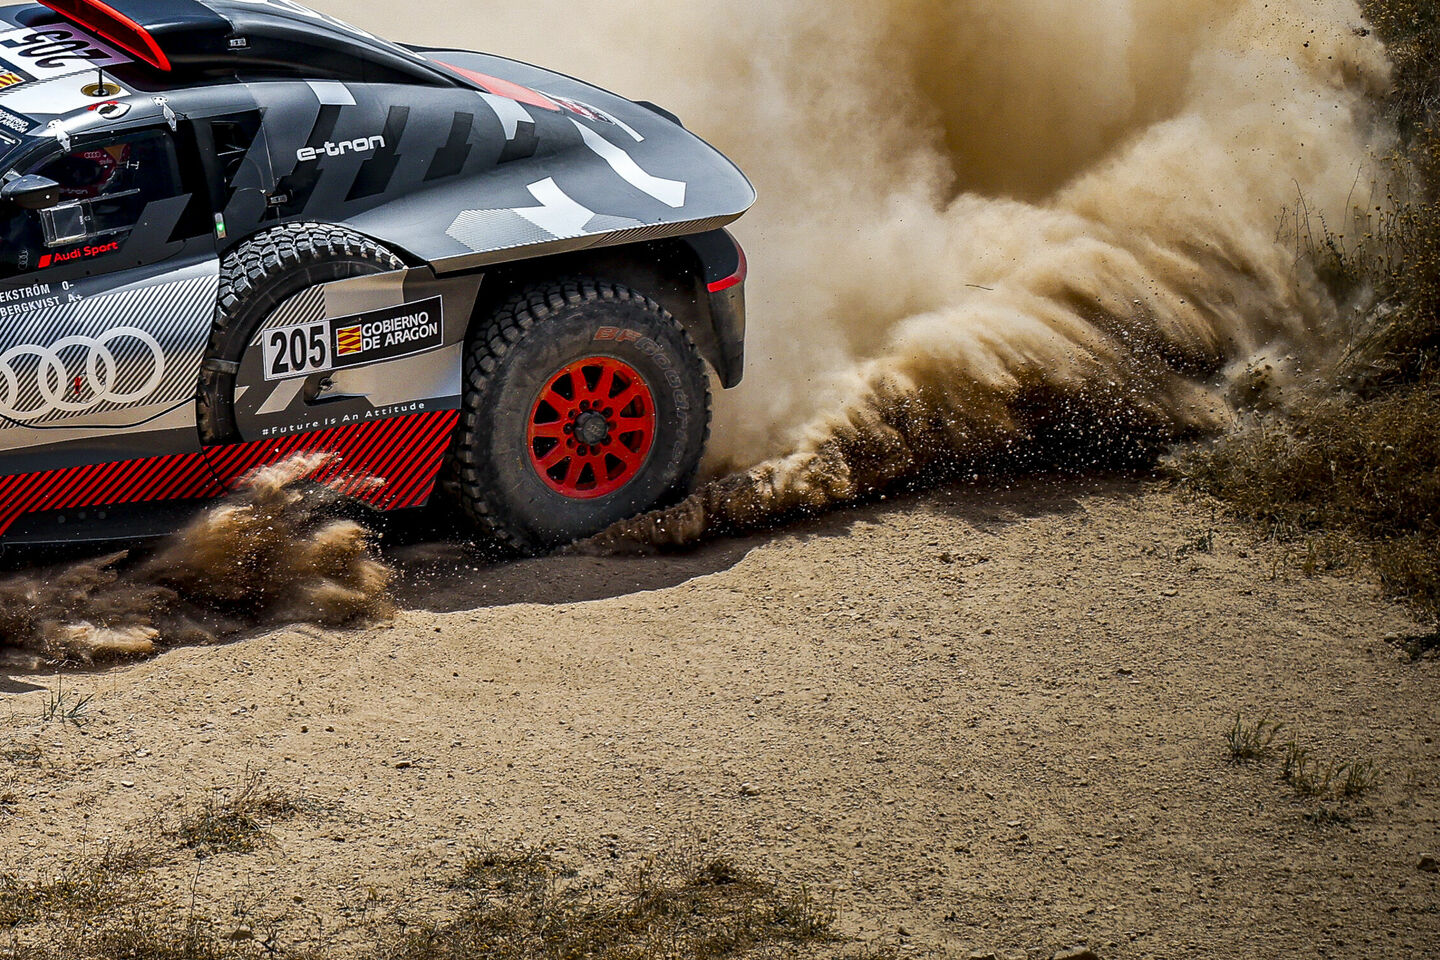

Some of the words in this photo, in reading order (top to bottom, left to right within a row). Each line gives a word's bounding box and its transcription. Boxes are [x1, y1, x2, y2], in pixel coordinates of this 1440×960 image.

[296, 134, 386, 162] e-tron
[53, 248, 81, 263] Audi
[83, 241, 119, 256] Sport
[0, 295, 60, 318] BERGKVIST
[66, 293, 84, 304] A+
[361, 311, 430, 337] GOBIERNO
[361, 337, 382, 352] DE
[384, 322, 439, 348] ARAGON
[269, 324, 327, 375] 205
[261, 420, 320, 436] #Future
[324, 417, 337, 426] Is
[341, 413, 359, 423] An
[364, 401, 426, 419] Attitude
